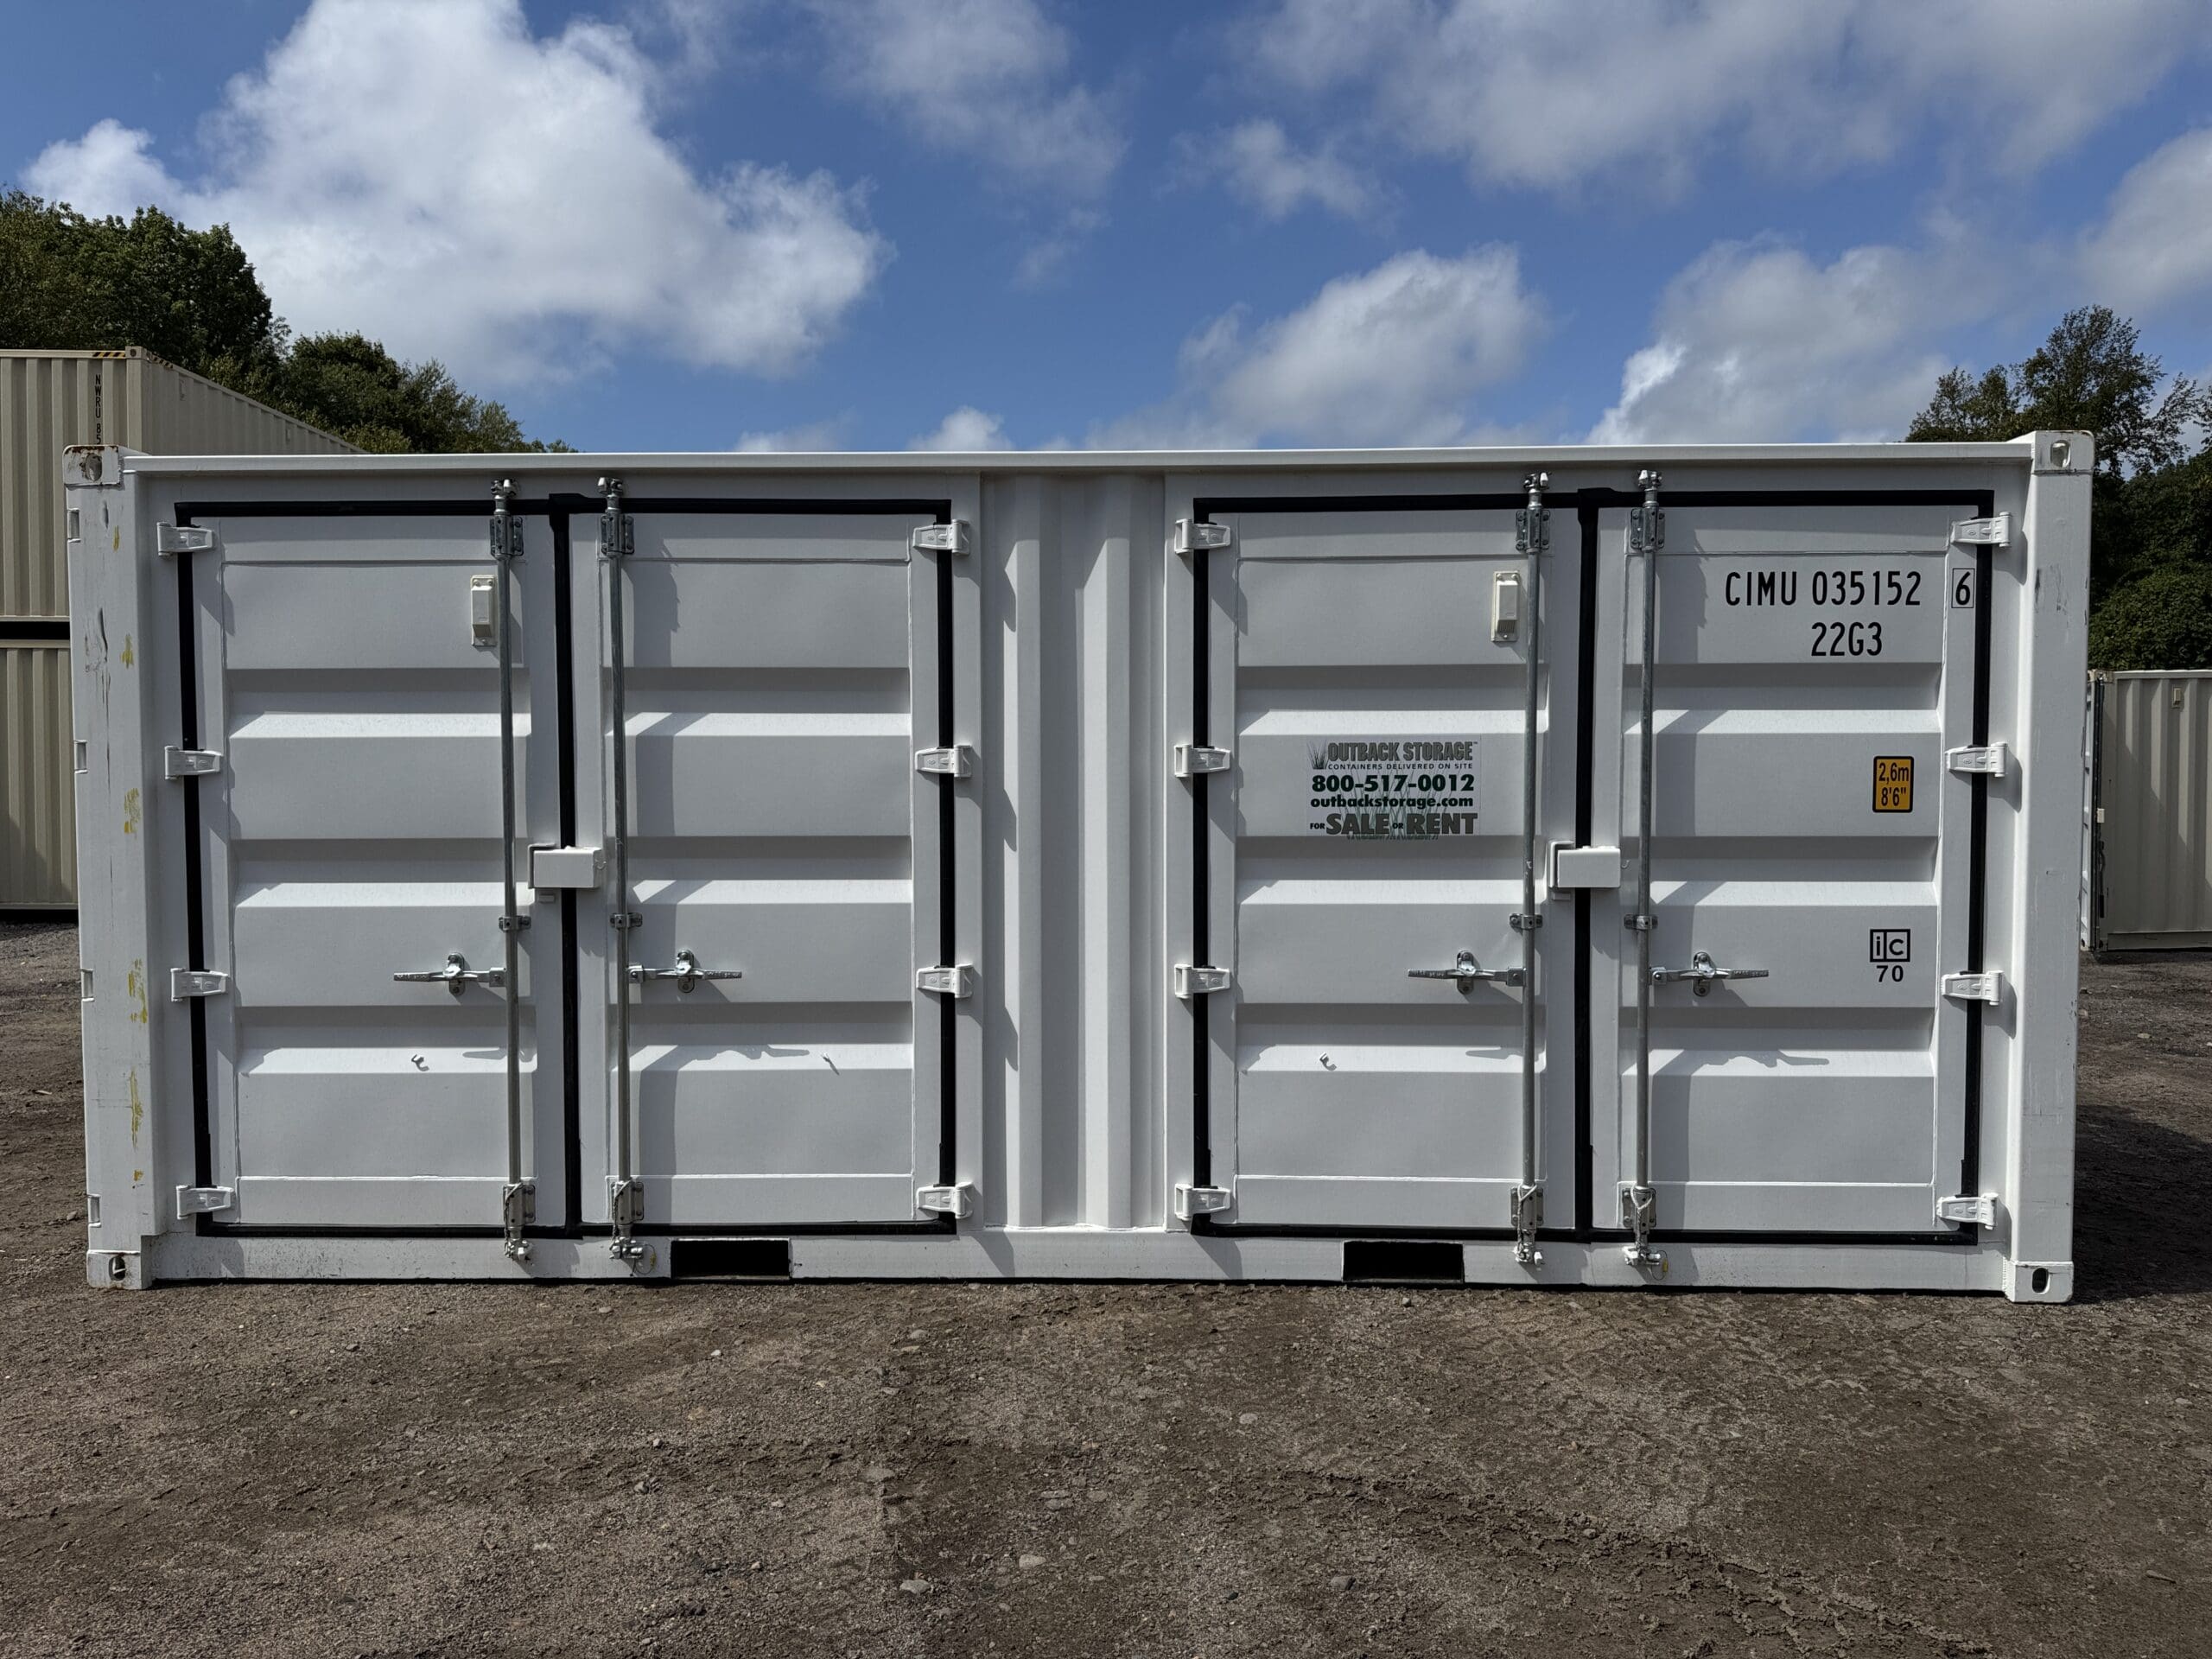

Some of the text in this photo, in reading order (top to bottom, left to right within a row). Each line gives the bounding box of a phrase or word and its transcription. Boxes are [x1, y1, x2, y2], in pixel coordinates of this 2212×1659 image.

[1725, 570, 1971, 606] CIMU 035152 6
[1811, 621, 1883, 657] 22G3
[1327, 741, 1473, 761] OUTBACK STORAGE
[1312, 774, 1475, 792] 800-517-0012
[1878, 762, 1910, 785] 2,6m
[1310, 794, 1474, 810] outbackstorage.com
[1881, 786, 1907, 806] 8'6"
[1325, 813, 1390, 835] SALE
[1406, 812, 1478, 835] RENT
[1876, 964, 1904, 982] 70
